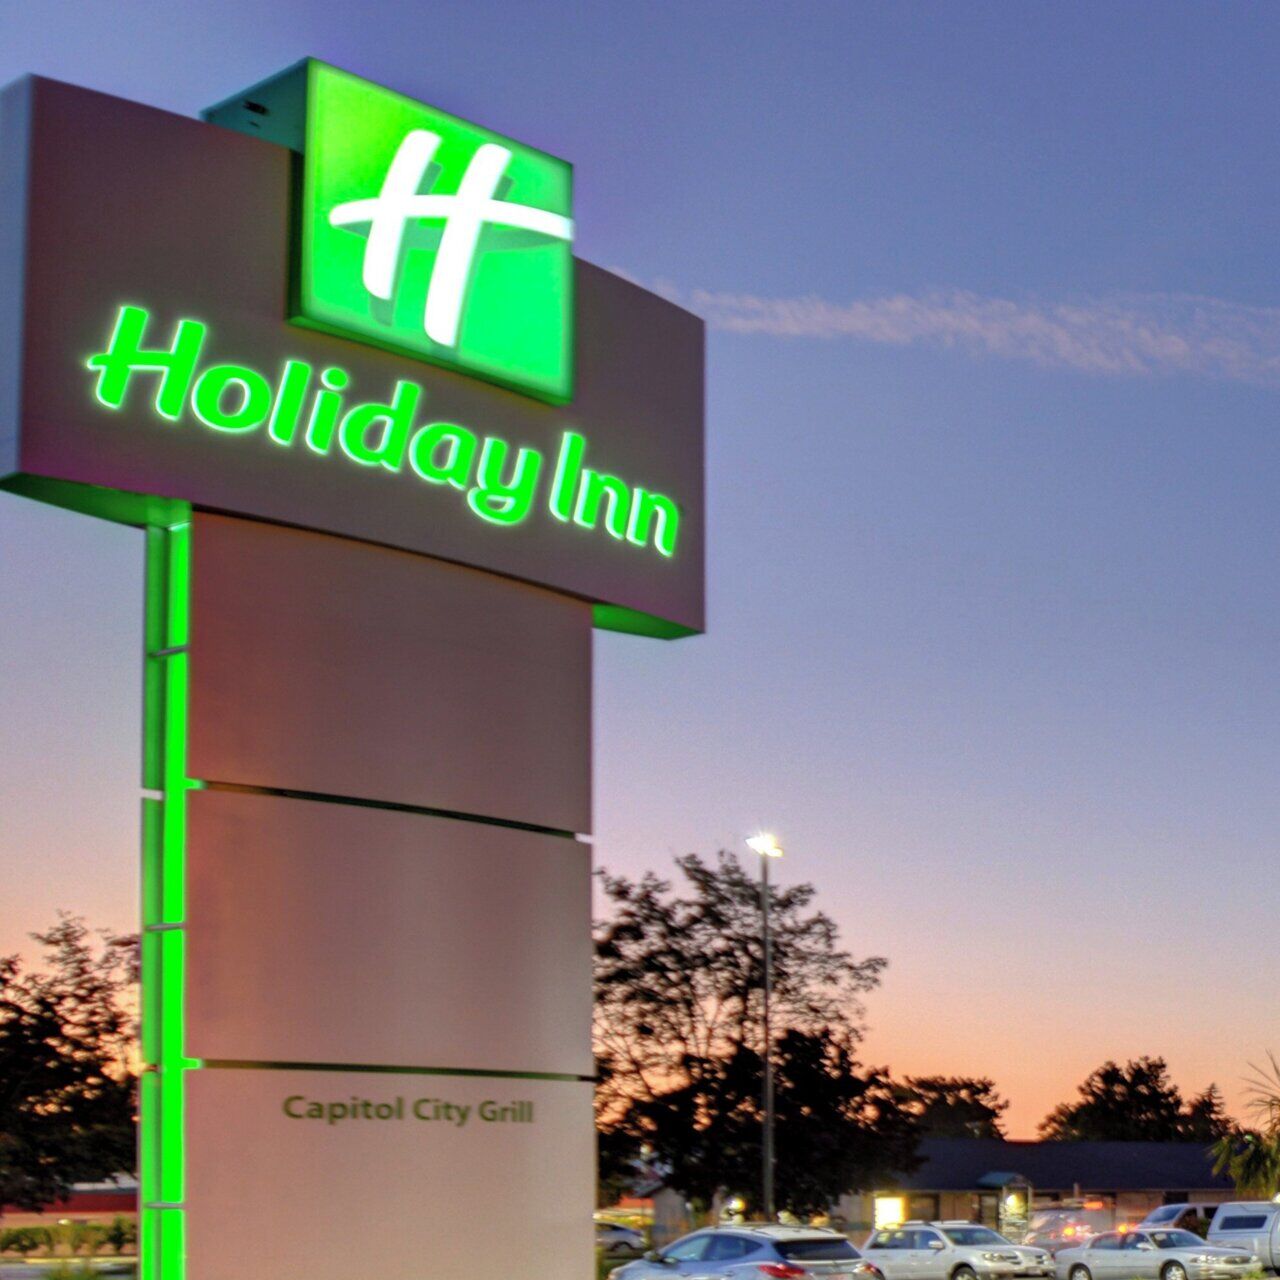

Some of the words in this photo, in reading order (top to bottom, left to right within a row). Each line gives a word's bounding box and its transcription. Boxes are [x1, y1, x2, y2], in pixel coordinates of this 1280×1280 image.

[87, 305, 541, 525] Holiday
[549, 431, 681, 557] Inn
[282, 1095, 404, 1124] Capitol
[413, 1097, 470, 1127] City
[478, 1100, 534, 1124] Grill
